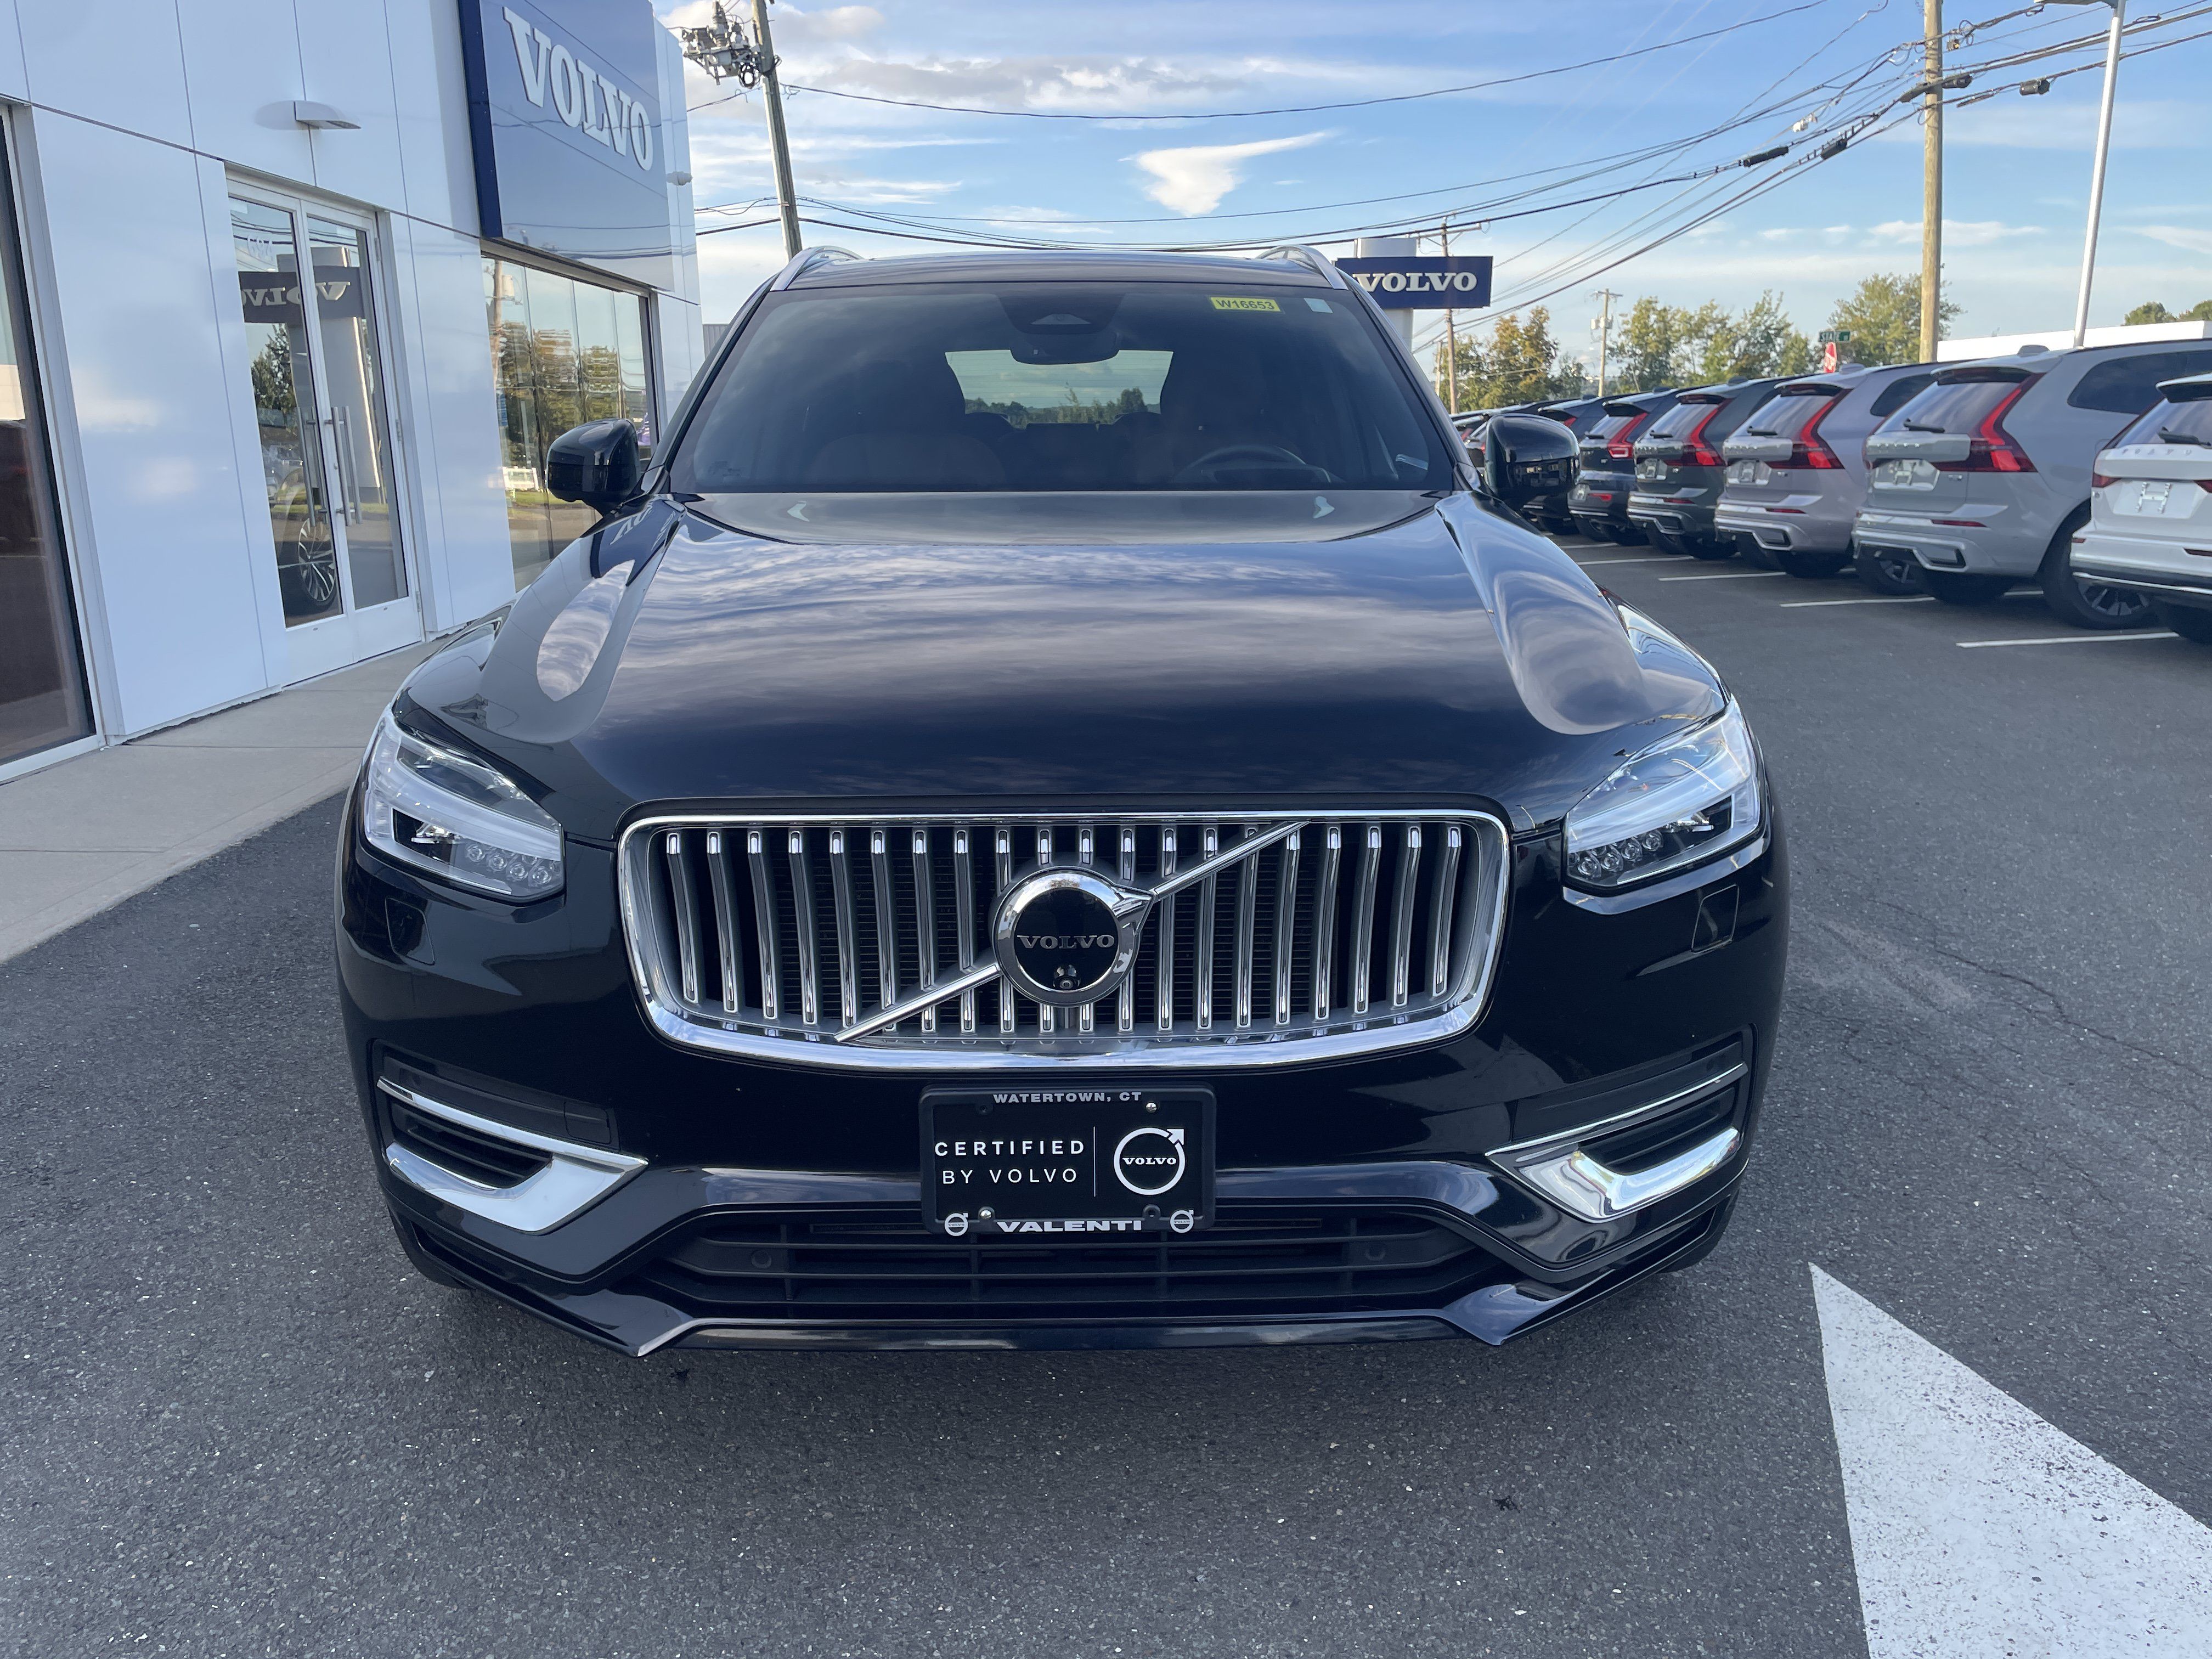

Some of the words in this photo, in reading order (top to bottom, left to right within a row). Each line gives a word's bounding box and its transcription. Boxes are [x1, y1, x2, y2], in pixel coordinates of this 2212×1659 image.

[503, 7, 653, 171] VOLVO
[1352, 272, 1477, 292] VOLVO
[1216, 300, 1275, 310] W16653
[1017, 934, 1115, 949] VOLVO
[994, 1092, 1111, 1103] WATERTOWN,
[1119, 1092, 1142, 1102] CT
[935, 1141, 1084, 1156] CERTIFIED
[943, 1170, 973, 1184] BY
[990, 1168, 1076, 1183] VOLVO
[997, 1220, 1142, 1232] VALENTI
